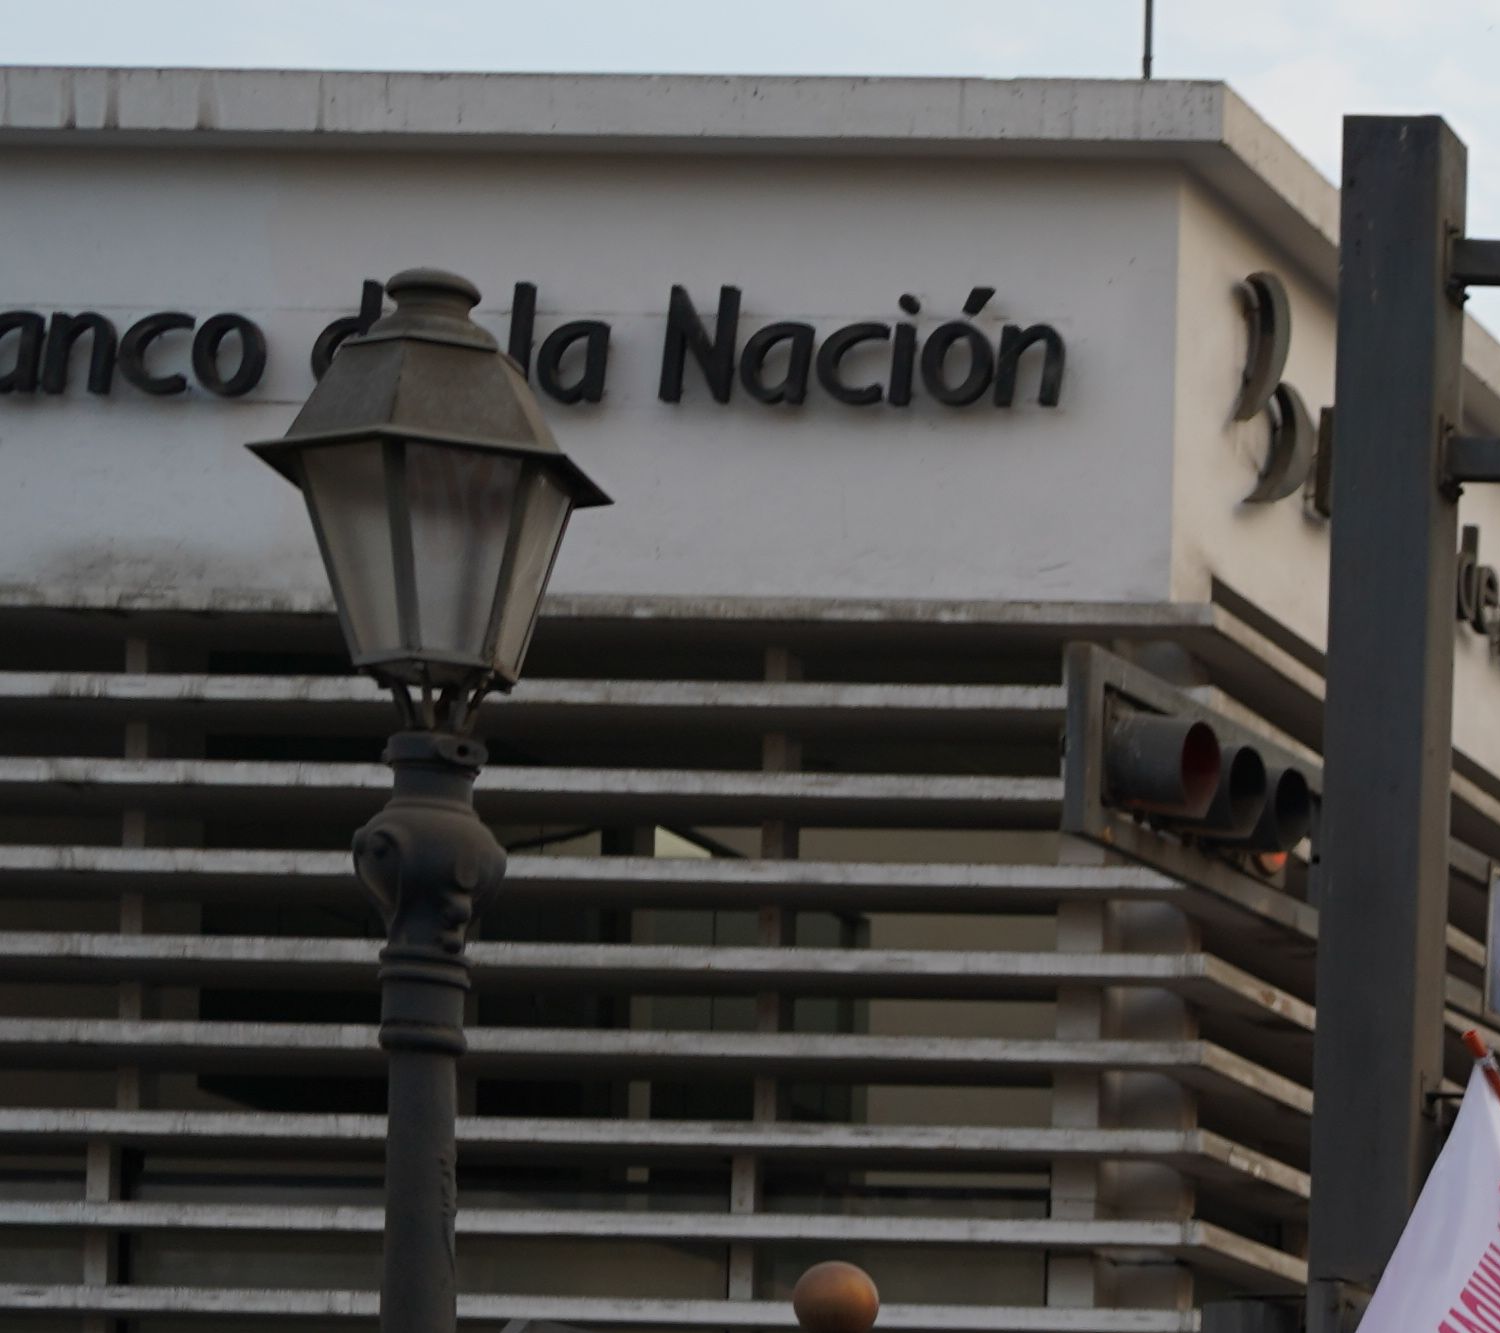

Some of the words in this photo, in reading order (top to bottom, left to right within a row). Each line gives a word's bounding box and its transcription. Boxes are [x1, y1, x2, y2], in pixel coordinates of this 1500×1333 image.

[508, 281, 612, 403] la
[658, 284, 1066, 408] Nación
[1456, 524, 1500, 634] de
